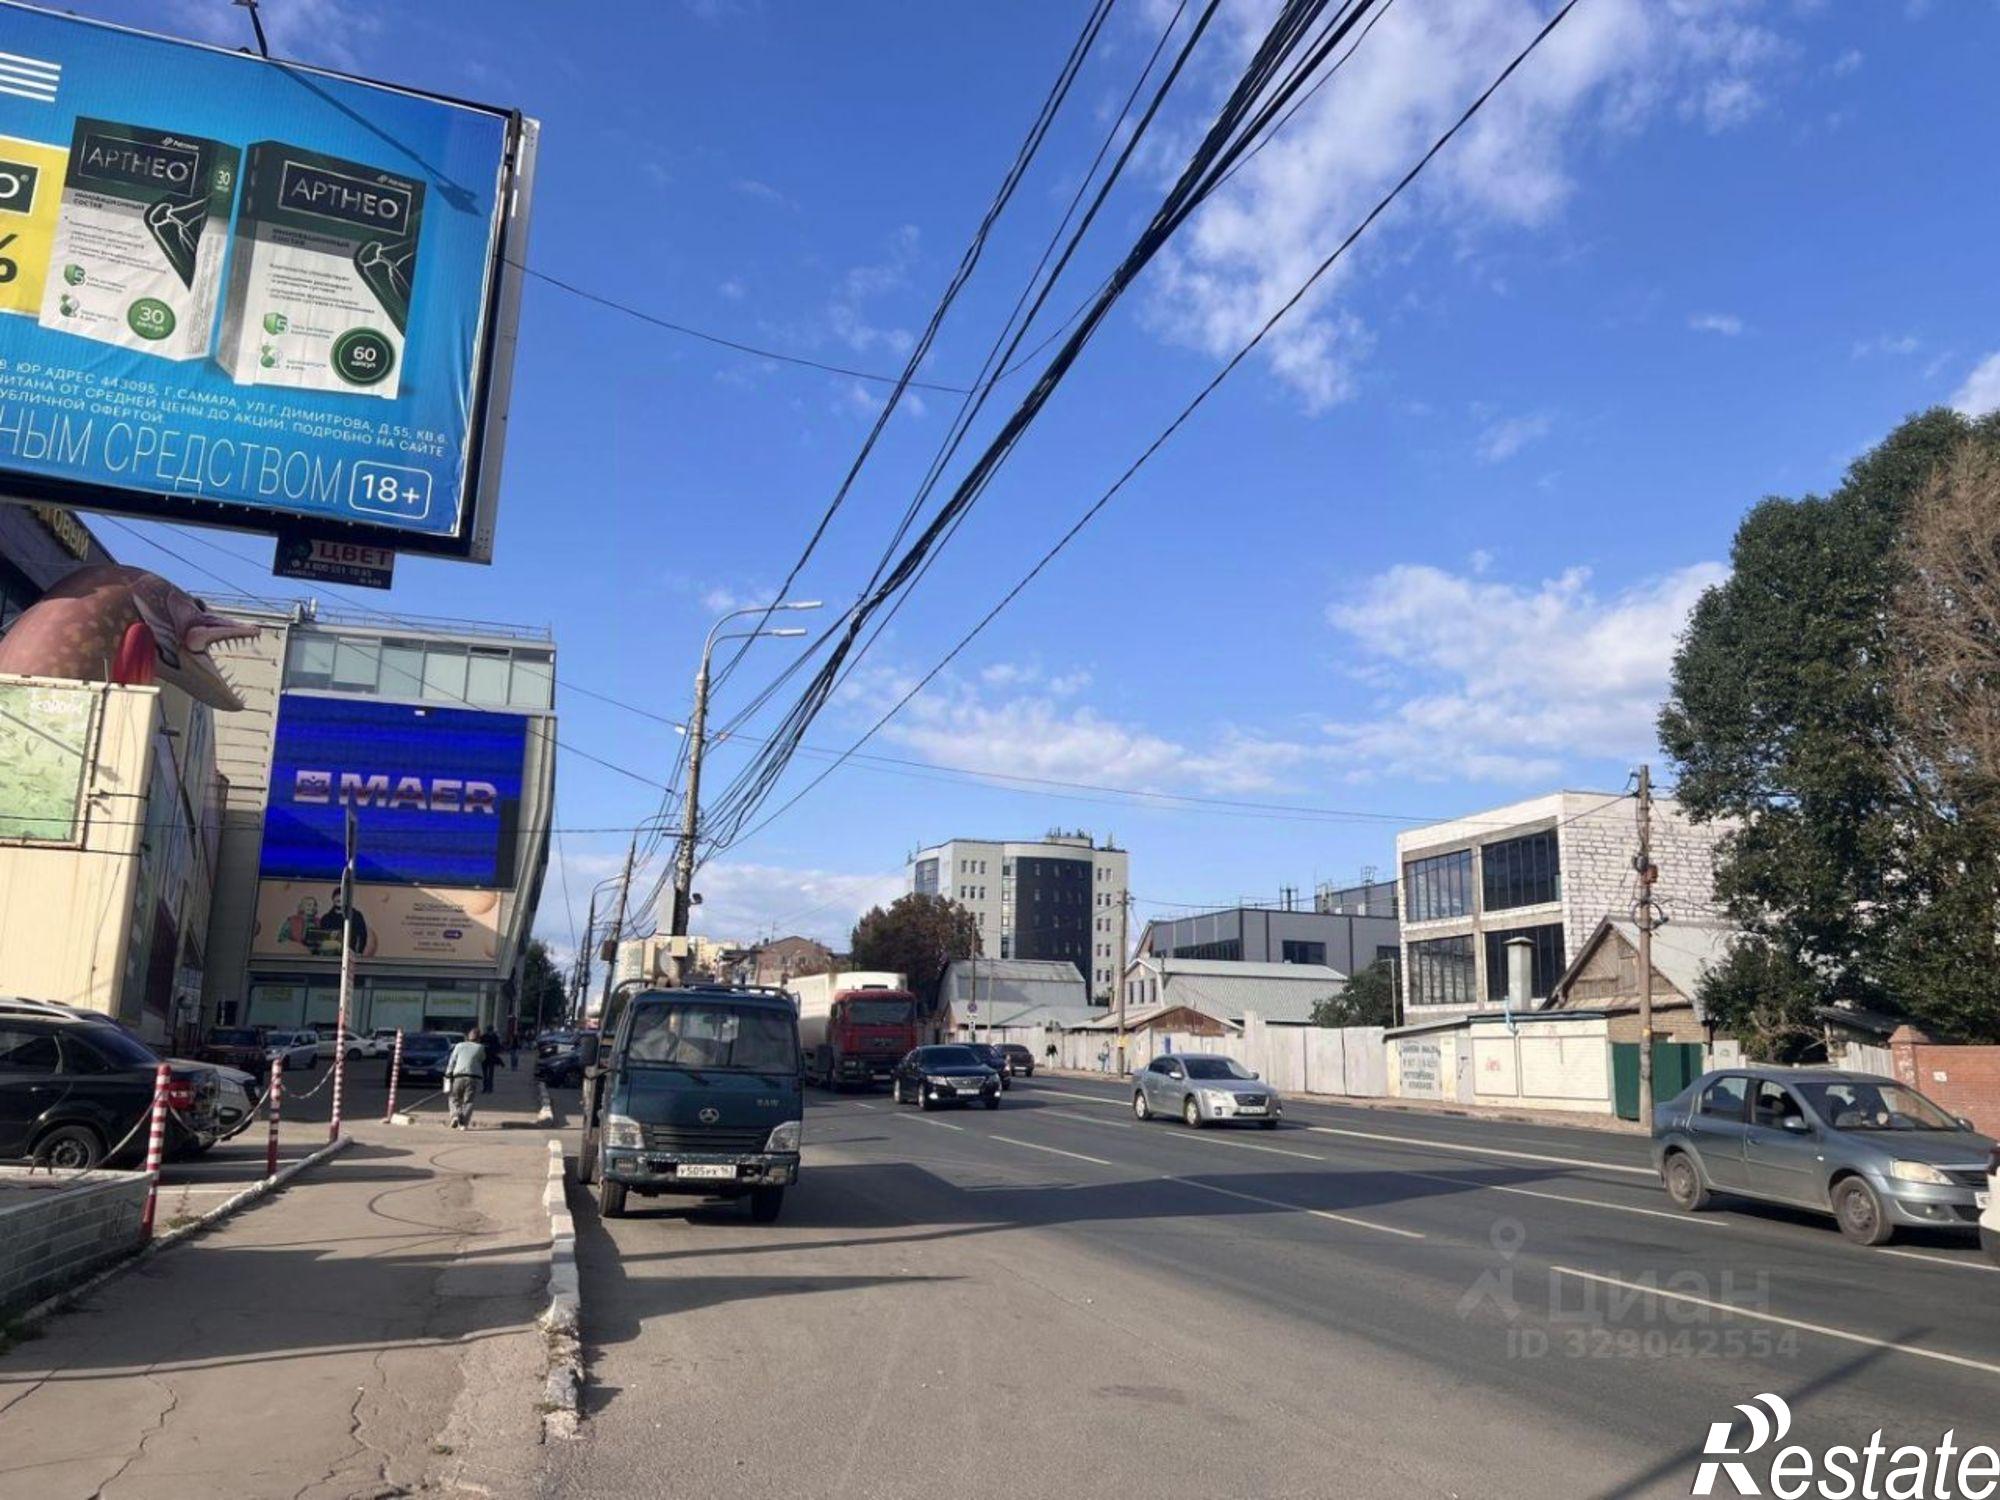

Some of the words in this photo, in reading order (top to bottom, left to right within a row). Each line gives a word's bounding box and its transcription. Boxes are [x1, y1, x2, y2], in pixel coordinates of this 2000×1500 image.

[139, 306, 166, 325] 30
[353, 346, 377, 361] 60
[45, 368, 96, 384] АДРЕС
[59, 382, 79, 396] ОТ
[85, 387, 157, 409] СРЕДНЕЙ
[161, 401, 203, 417] ЦЕНЫ
[207, 408, 229, 421] ДО
[293, 421, 372, 445] ПОДРОБНО
[376, 437, 395, 449] НА
[399, 440, 444, 457] САЙТЕ
[104, 422, 342, 504] СРЕДСТВОМ
[361, 473, 420, 505] 18+
[320, 543, 391, 567] ЦВЕТ
[339, 773, 498, 814] MAER
